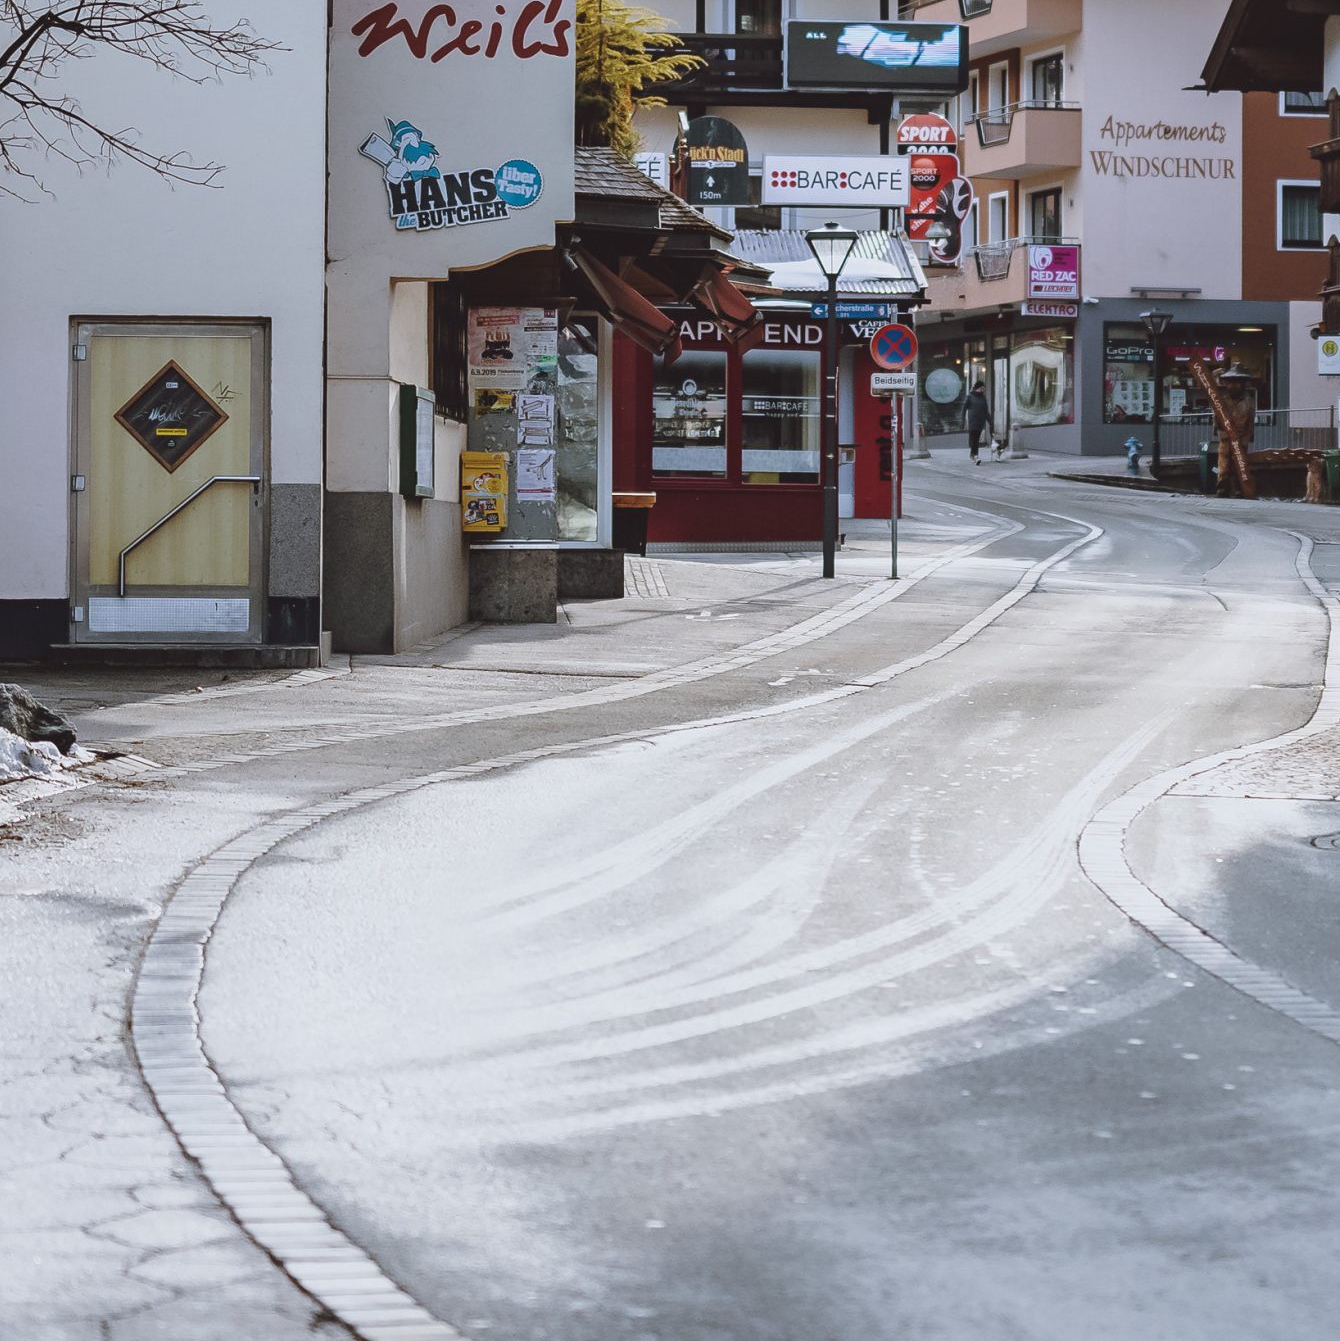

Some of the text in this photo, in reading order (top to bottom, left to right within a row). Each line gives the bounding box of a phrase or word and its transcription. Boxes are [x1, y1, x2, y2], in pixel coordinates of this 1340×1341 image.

[900, 126, 950, 142] SPORT
[1100, 115, 1227, 147] Appartements
[911, 167, 938, 175] SPORT
[1089, 150, 1236, 179] WINDSCHNUR
[389, 168, 498, 214] HANS
[498, 179, 538, 199] Tasty!
[699, 191, 722, 200] 150m
[398, 202, 508, 228] the BUTCHER
[1031, 270, 1077, 282] RED ZAC
[1027, 303, 1076, 315] ELEKTRO
[764, 324, 823, 345] END
[1106, 345, 1154, 355] GoPro
[874, 376, 915, 386] Beidseitig
